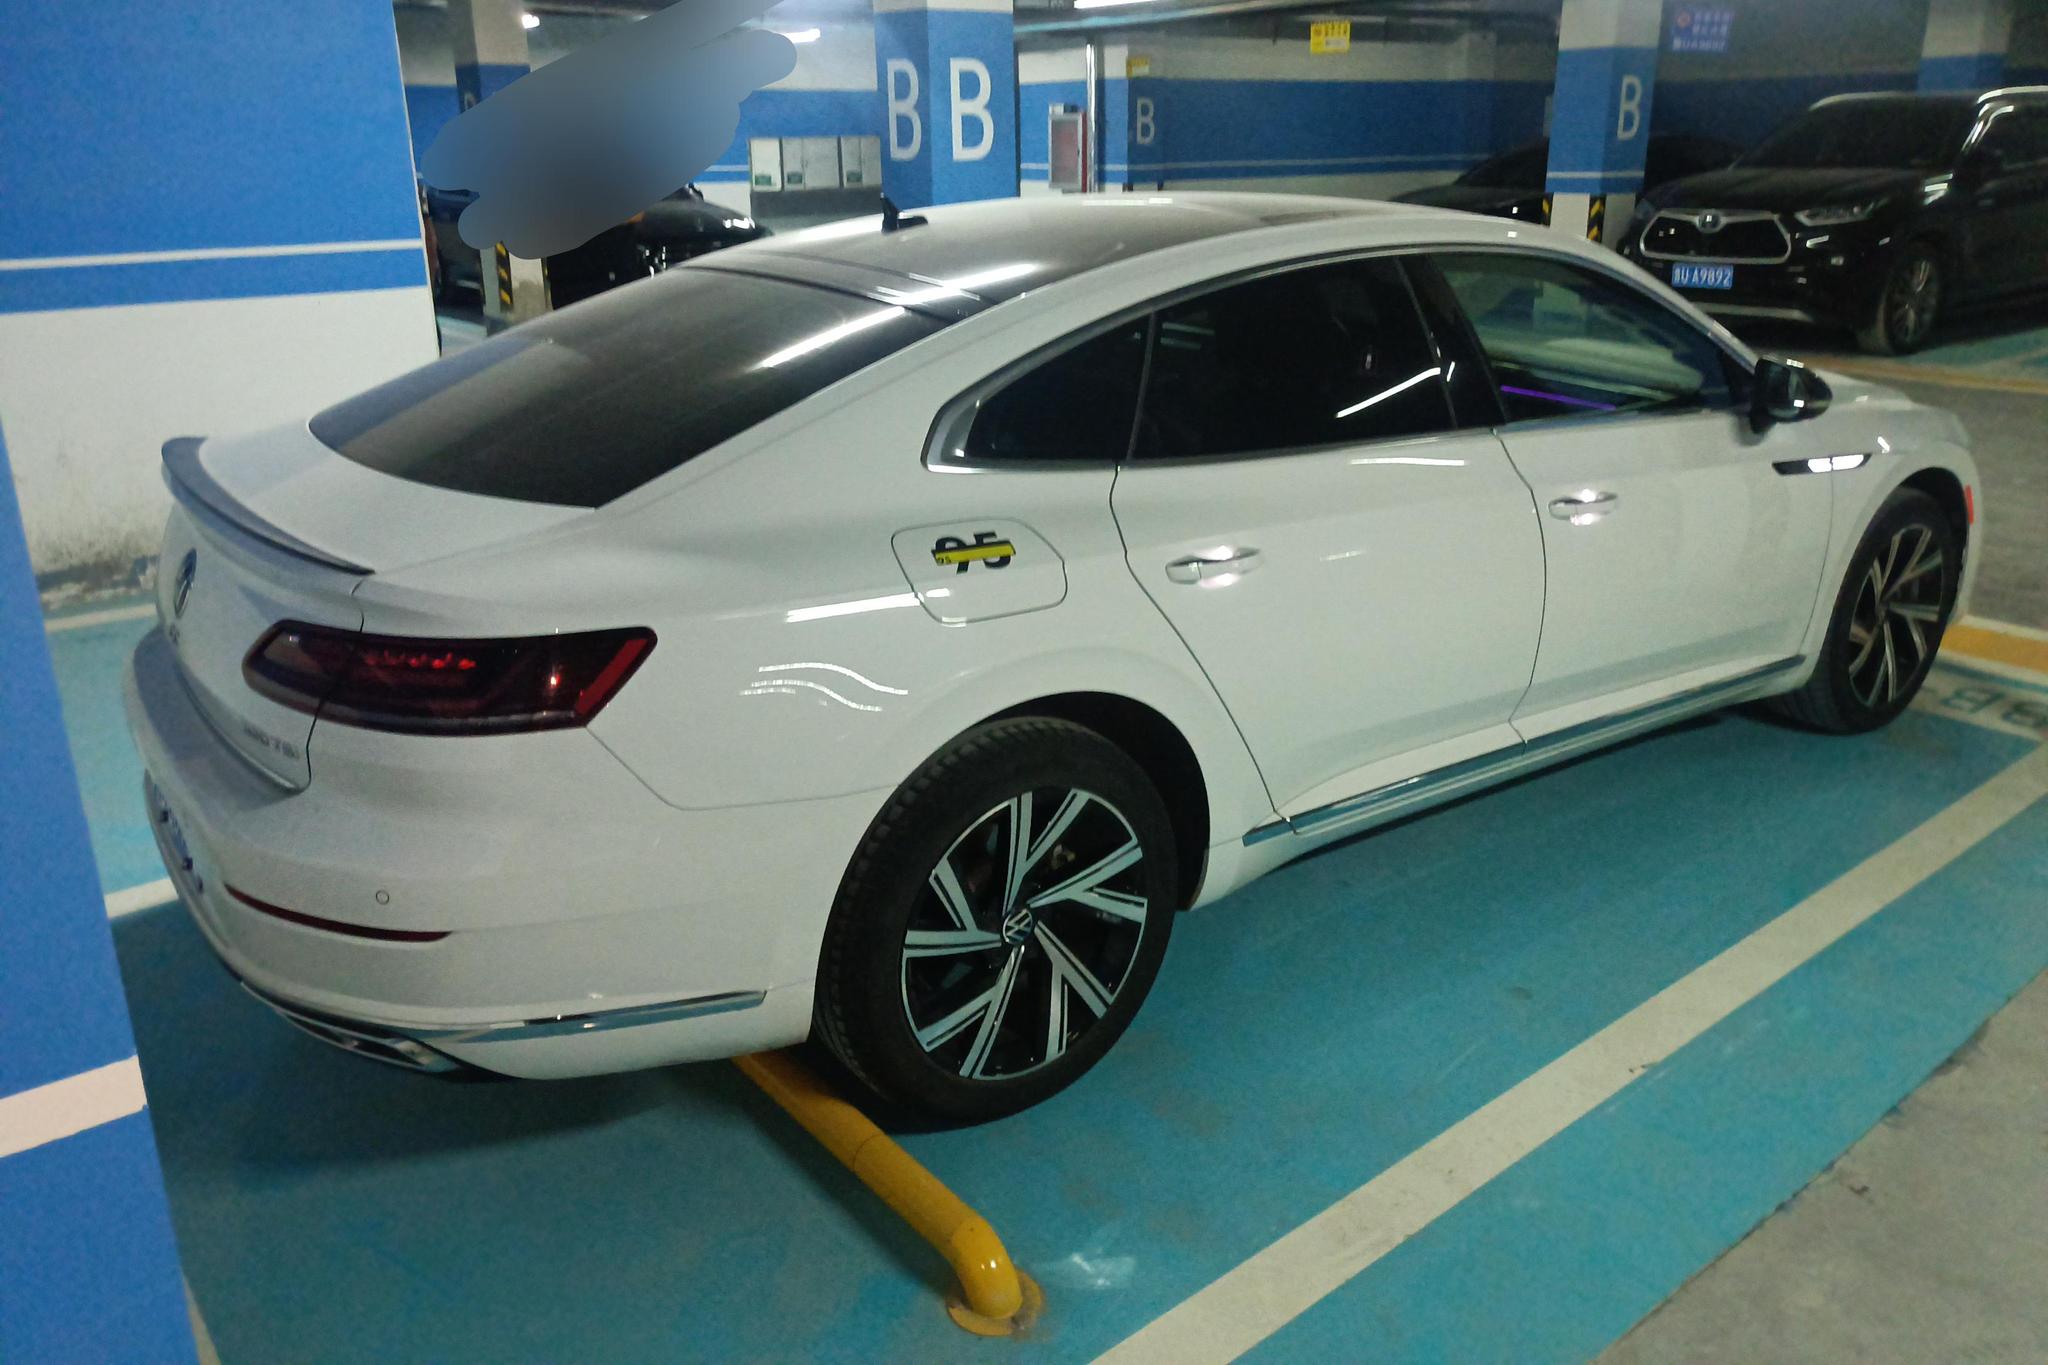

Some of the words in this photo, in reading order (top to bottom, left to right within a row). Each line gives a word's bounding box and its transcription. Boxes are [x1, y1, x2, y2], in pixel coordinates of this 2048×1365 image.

[887, 58, 922, 161] B
[950, 57, 994, 161] B
[1136, 96, 1155, 145] B
[1616, 74, 1643, 141] B
